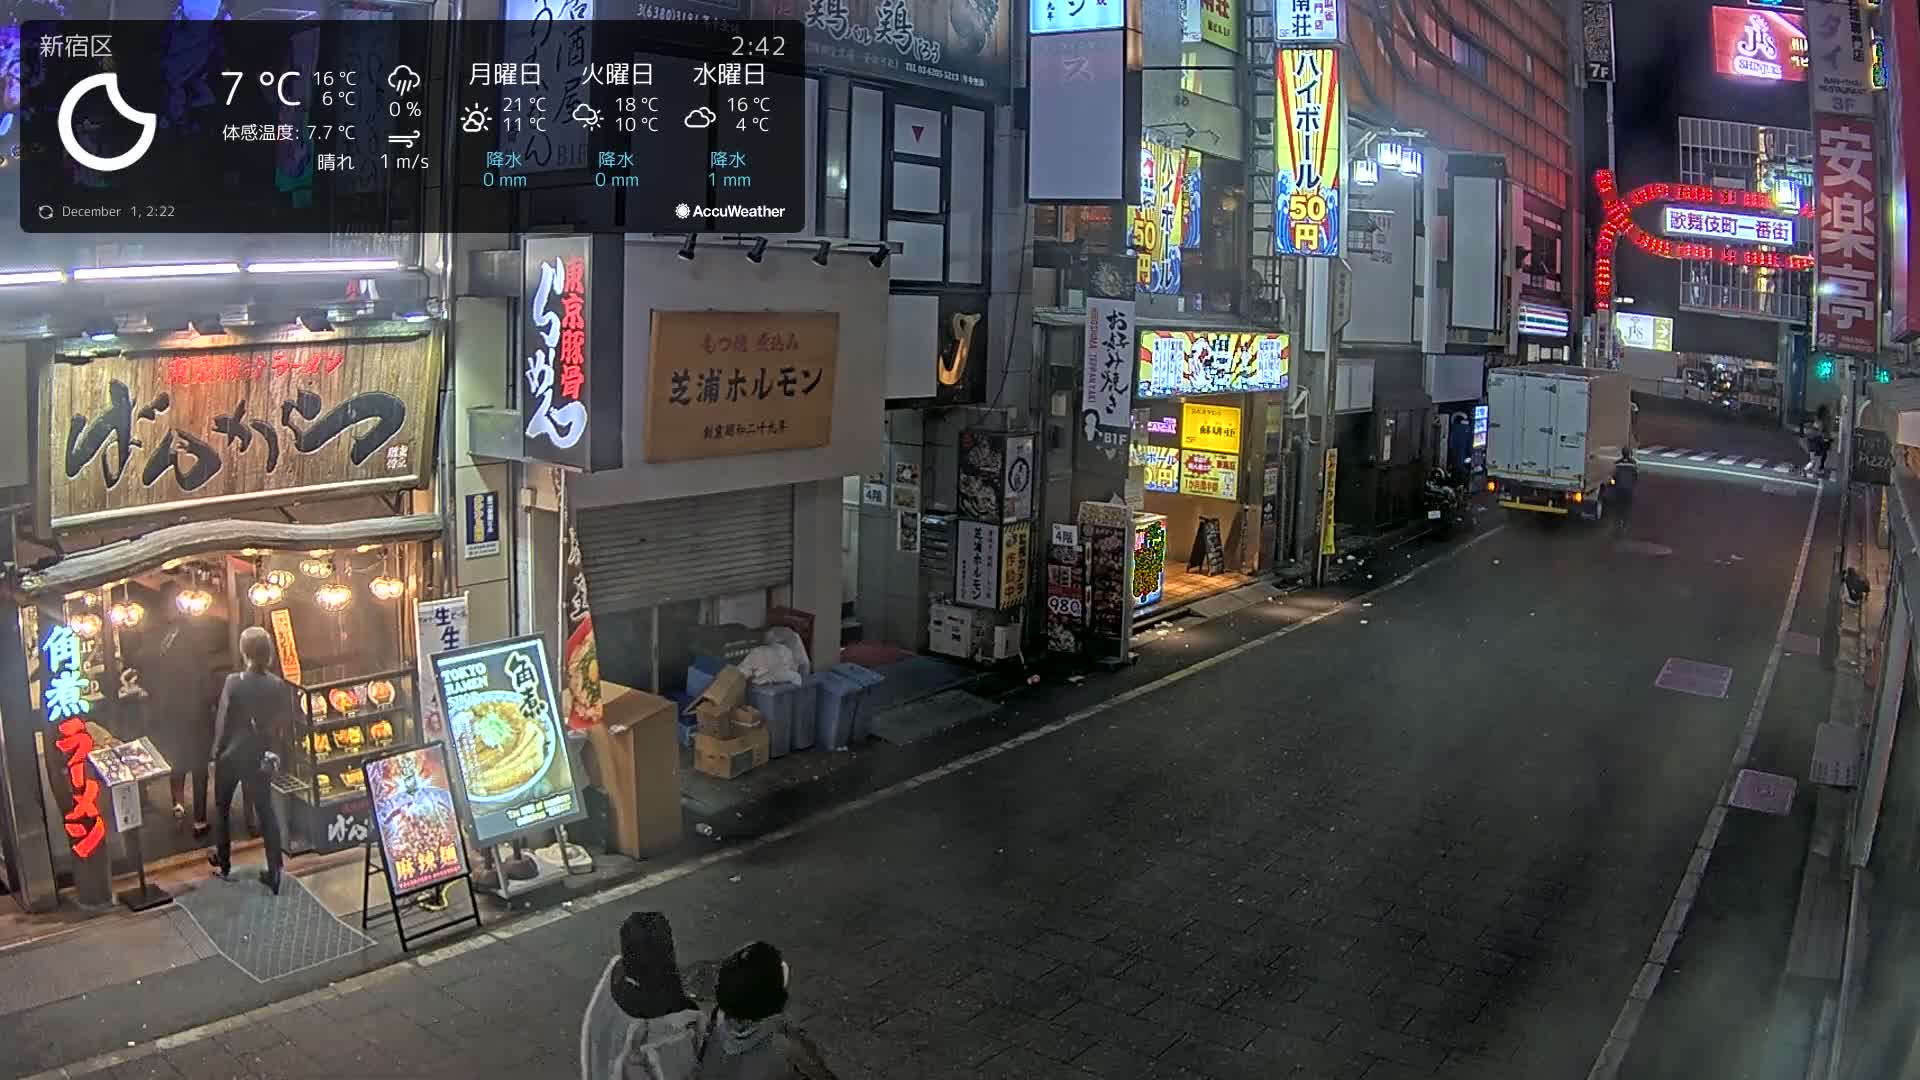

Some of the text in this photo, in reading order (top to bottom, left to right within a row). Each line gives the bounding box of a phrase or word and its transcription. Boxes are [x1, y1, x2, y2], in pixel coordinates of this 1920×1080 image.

[1588, 63, 1609, 79] 7F
[1296, 54, 1321, 189] ハイボール
[1670, 210, 1790, 241] 歌舞伎町一番街
[1818, 126, 1875, 329] 安楽亭
[560, 255, 586, 400] 東京豚骨
[1818, 332, 1837, 346] 2F
[1099, 309, 1130, 415] お好み焼き
[668, 366, 824, 406] 芝浦ホルモン
[1048, 596, 1082, 615] 980
[43, 625, 90, 721] 角煮
[441, 662, 487, 683] TOKYO
[444, 676, 489, 695] RAMEN
[56, 717, 106, 858] ラーメン
